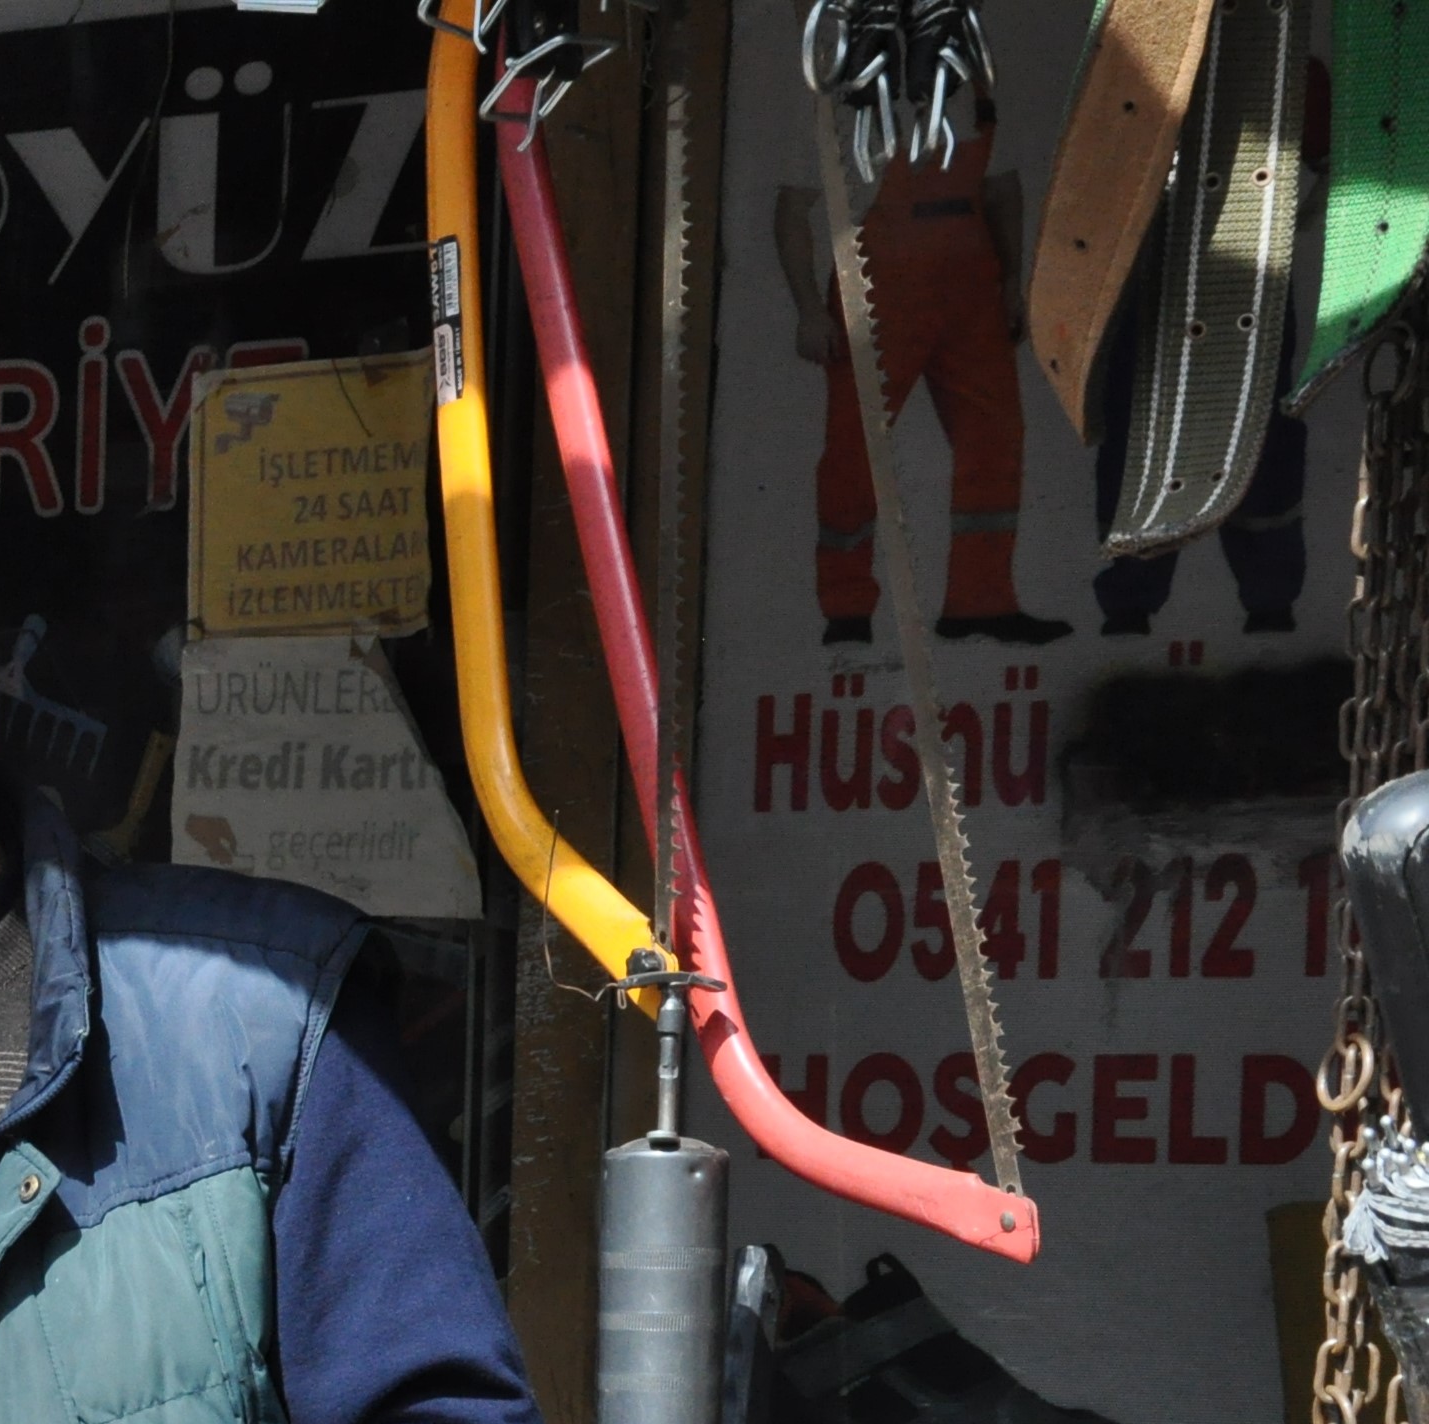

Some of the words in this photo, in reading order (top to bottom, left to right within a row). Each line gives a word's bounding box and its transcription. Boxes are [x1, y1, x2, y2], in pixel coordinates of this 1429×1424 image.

[294, 497, 327, 525] 24
[338, 487, 413, 520] SAAT
[186, 741, 306, 790] Kredi
[753, 666, 1049, 812] Hüsnü
[1100, 852, 1257, 980] 212
